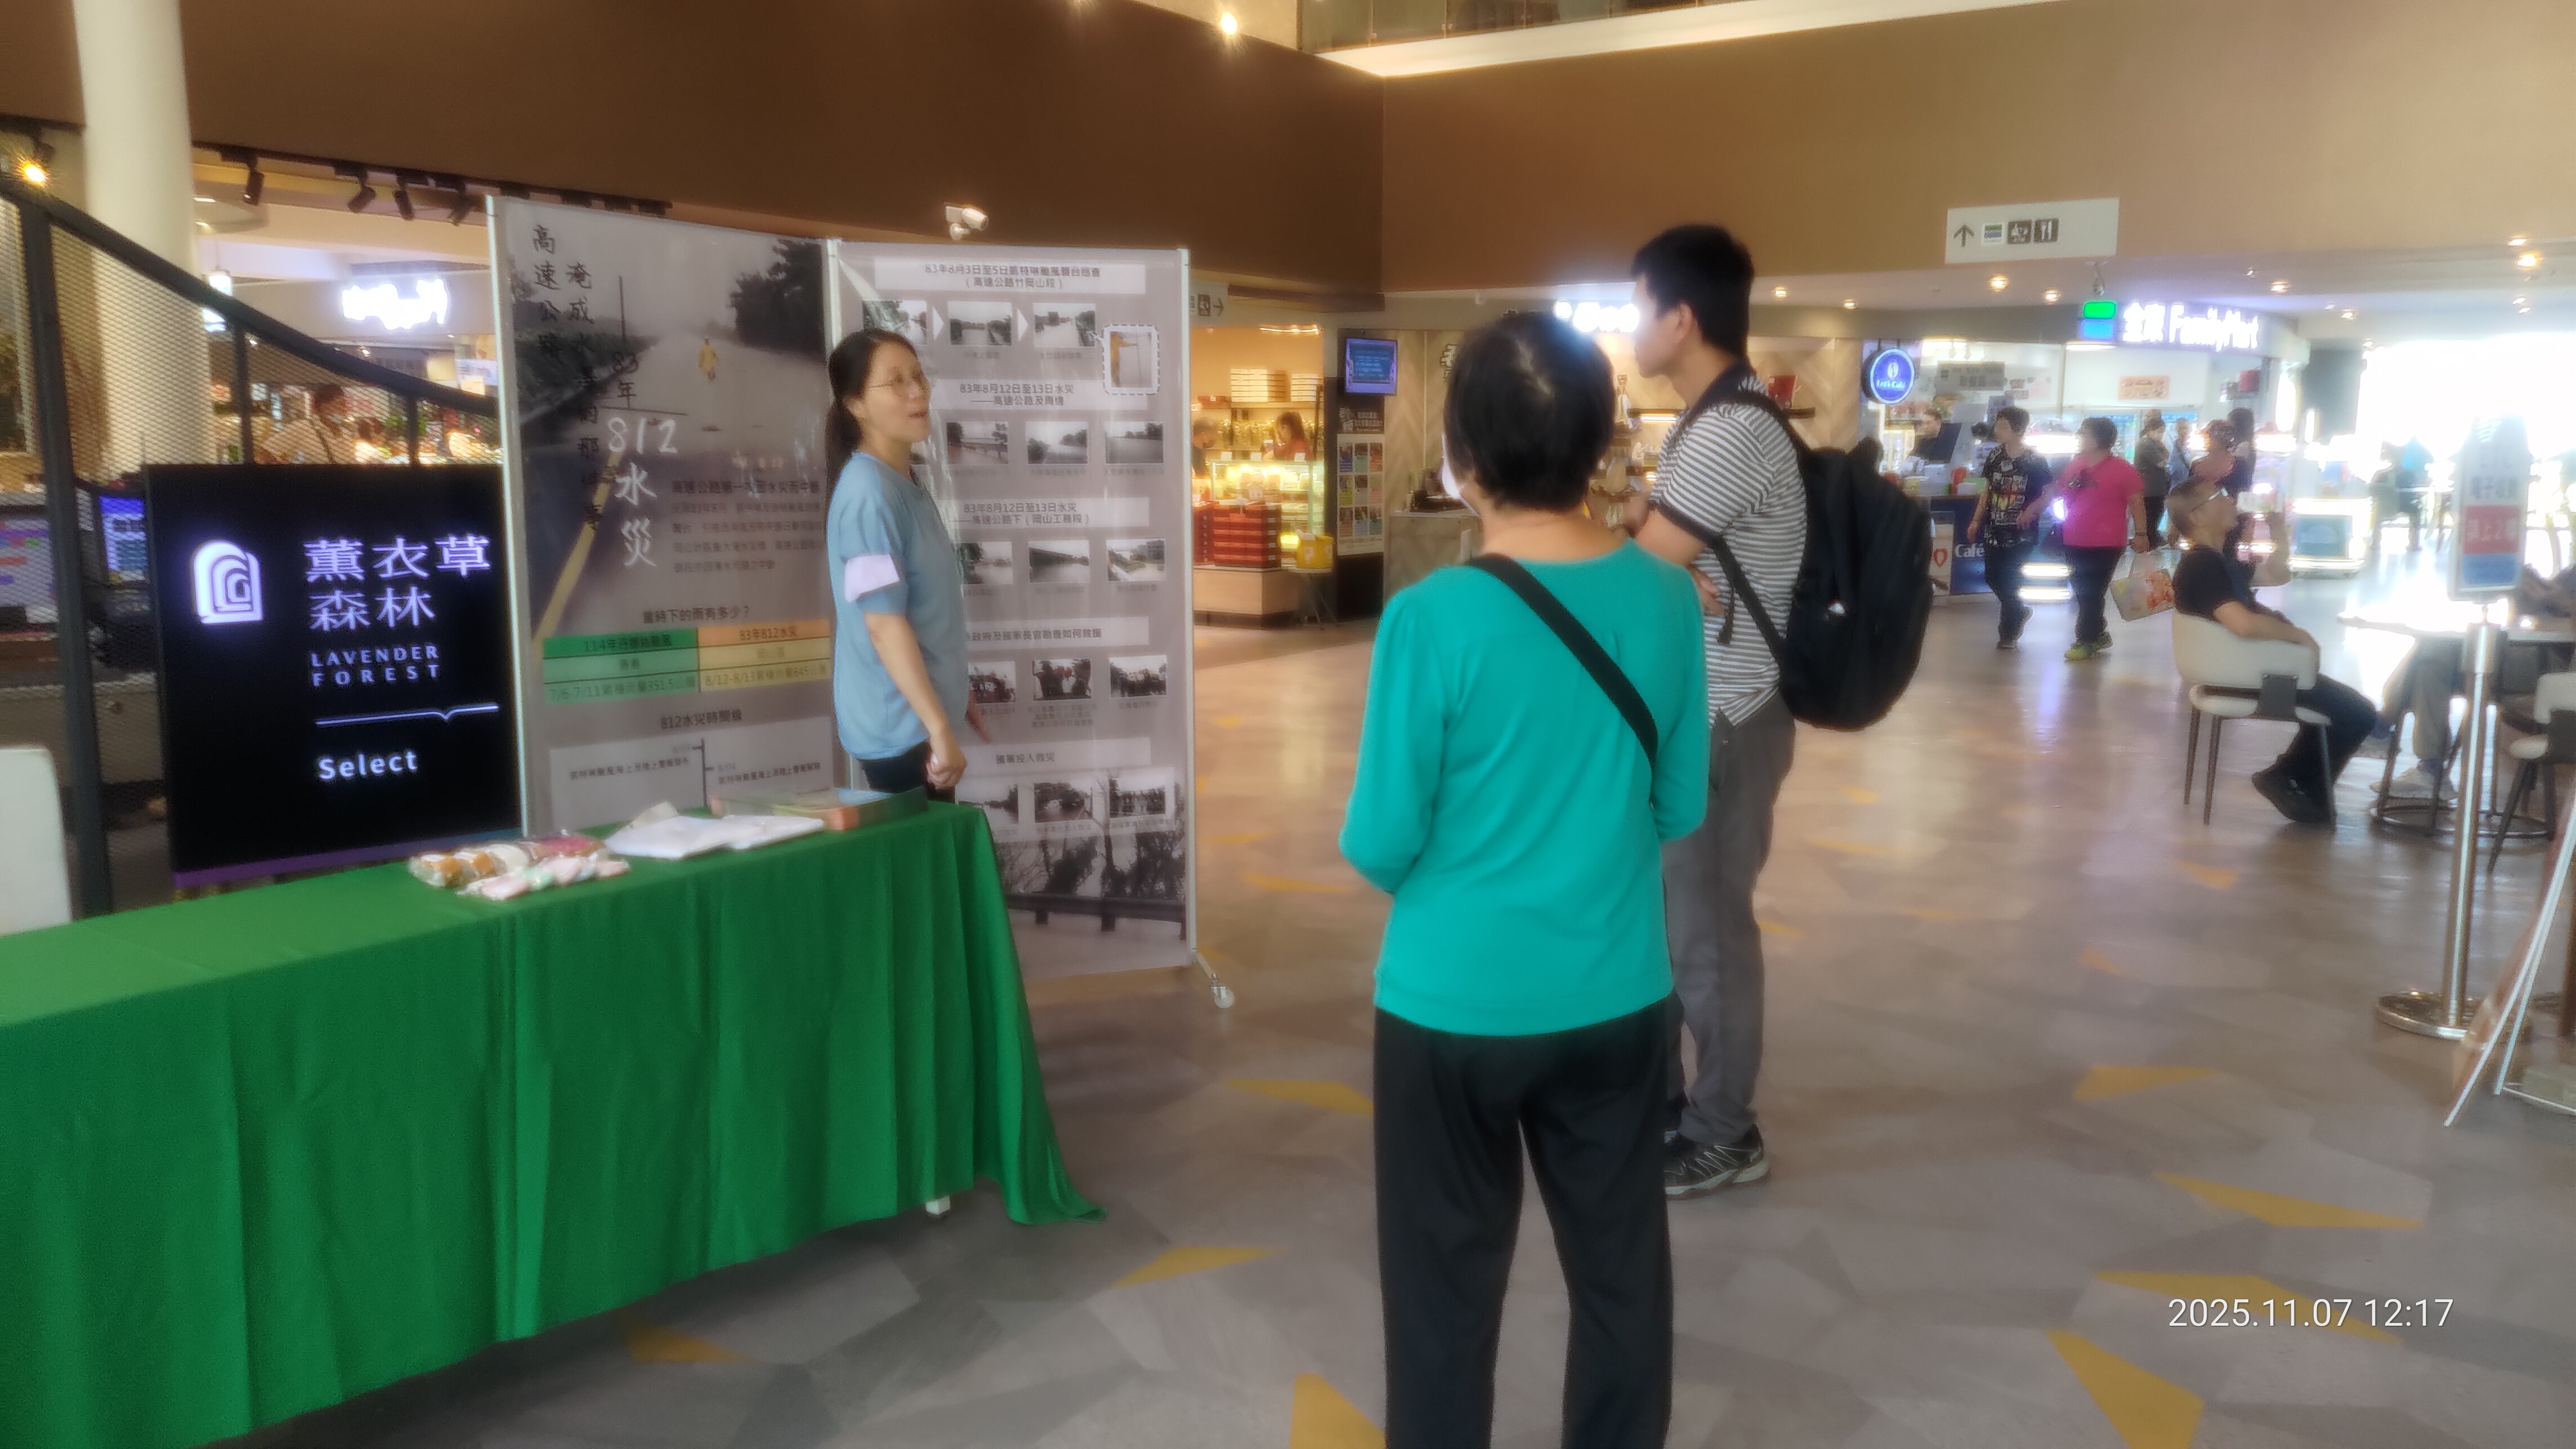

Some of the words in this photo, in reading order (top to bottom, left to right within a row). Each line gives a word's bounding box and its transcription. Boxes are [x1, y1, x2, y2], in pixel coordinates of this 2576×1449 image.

[607, 417, 678, 454] 812
[615, 461, 658, 566] 水災
[303, 534, 491, 583] 薰衣草
[1955, 543, 1985, 558] Café
[308, 585, 436, 632] 森林
[311, 645, 440, 667] LAVENDER
[312, 664, 440, 686] FOREST
[317, 749, 418, 781] Select
